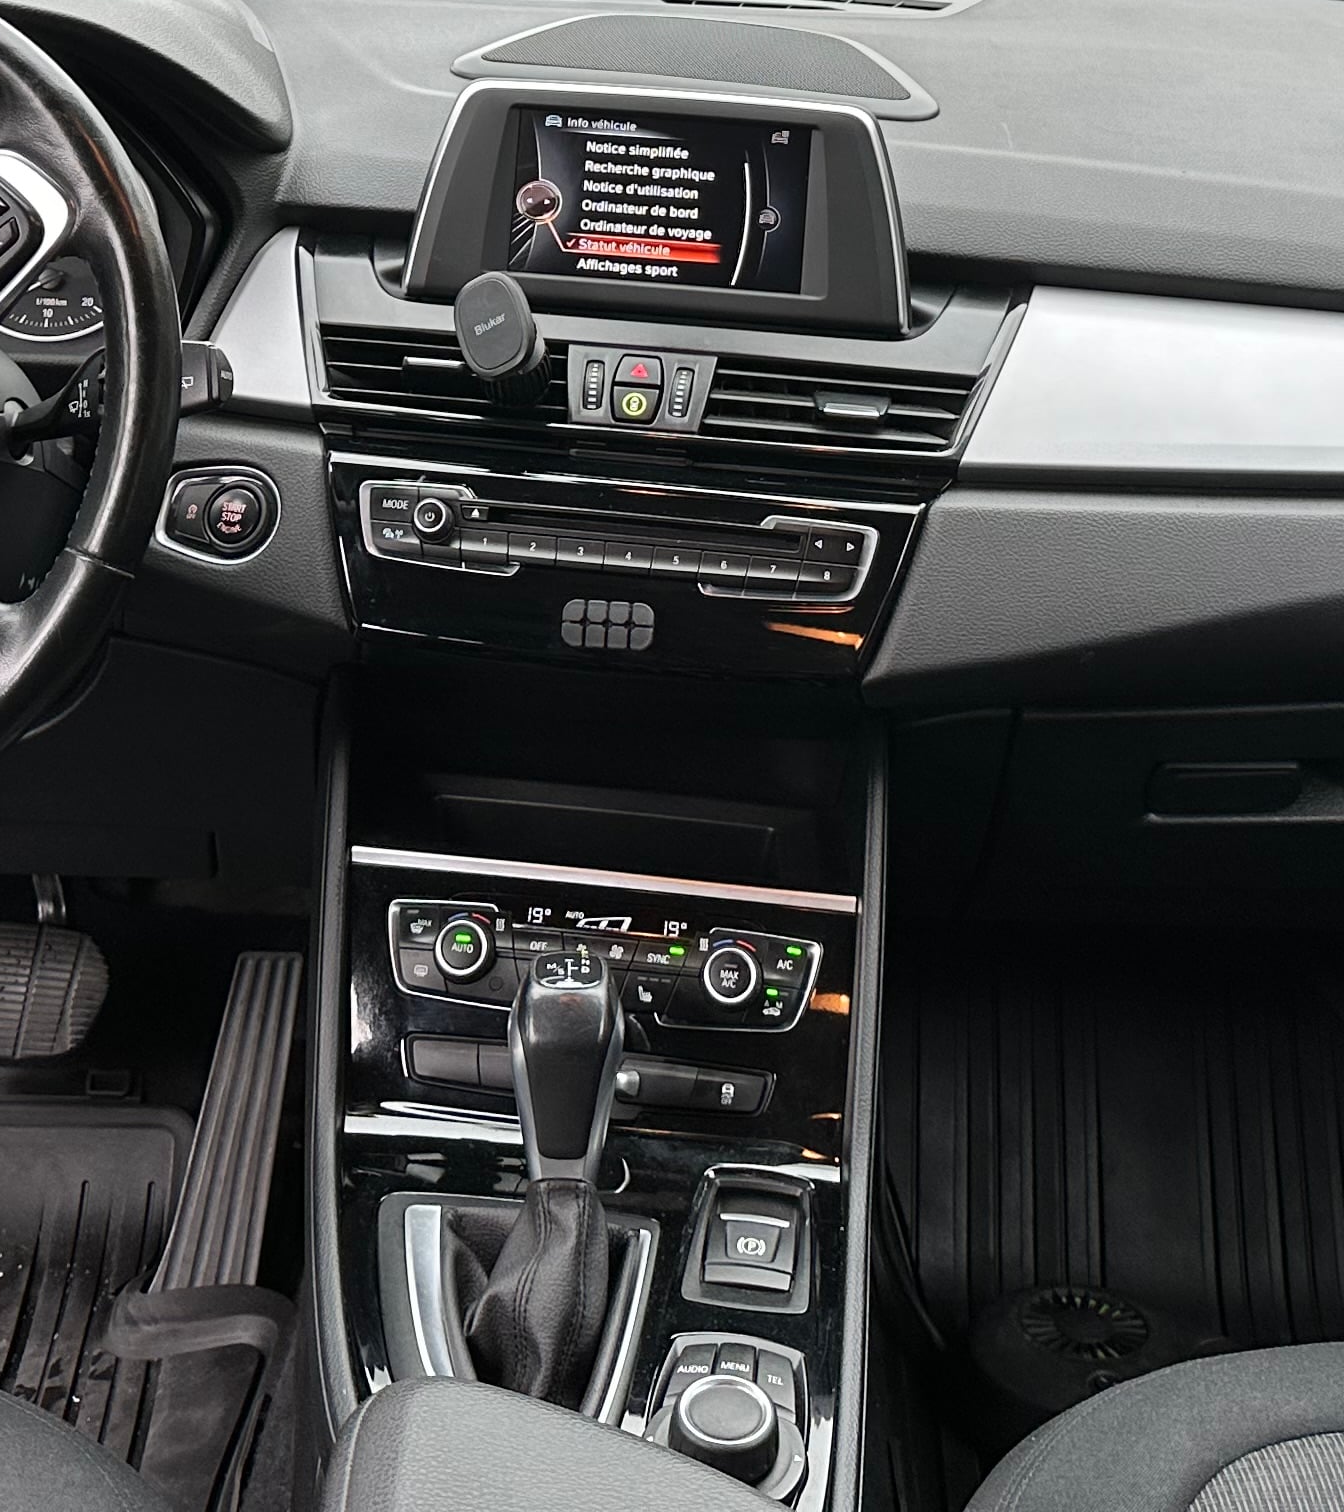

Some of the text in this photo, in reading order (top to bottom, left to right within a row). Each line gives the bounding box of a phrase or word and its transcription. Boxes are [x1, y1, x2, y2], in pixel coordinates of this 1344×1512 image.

[567, 117, 637, 132] Info véhicule
[586, 141, 689, 159] Notice simplifiée
[585, 160, 715, 181] Recherche graphique
[583, 180, 699, 199] Notice d'utilisation
[582, 199, 699, 219] Ordinateur de bord
[580, 219, 712, 241] Ordinateur de voyage
[579, 239, 670, 256] Statut véhicule
[577, 258, 678, 277] Affichages sport
[81, 297, 94, 307] 20
[42, 308, 54, 318] 10
[474, 313, 505, 336] Blukar
[222, 501, 247, 513] START
[382, 499, 409, 510] MODE
[221, 512, 242, 522] STOP
[529, 541, 537, 552] 2
[577, 546, 584, 556] 3
[624, 551, 632, 561] 4
[672, 555, 680, 565] 5
[720, 560, 728, 570] 6
[770, 564, 777, 574] 7
[823, 570, 831, 580] 8
[565, 910, 585, 920] AUTO
[451, 942, 474, 954] AUTO
[529, 941, 548, 951] OFF
[646, 952, 671, 964] SYNC
[581, 965, 590, 974] D
[776, 959, 794, 970] A/C
[720, 969, 739, 980] MAX
[721, 979, 736, 988] A/C
[677, 1364, 709, 1374] AUDIO
[720, 1361, 750, 1372] MENU
[767, 1374, 784, 1386] TEL
